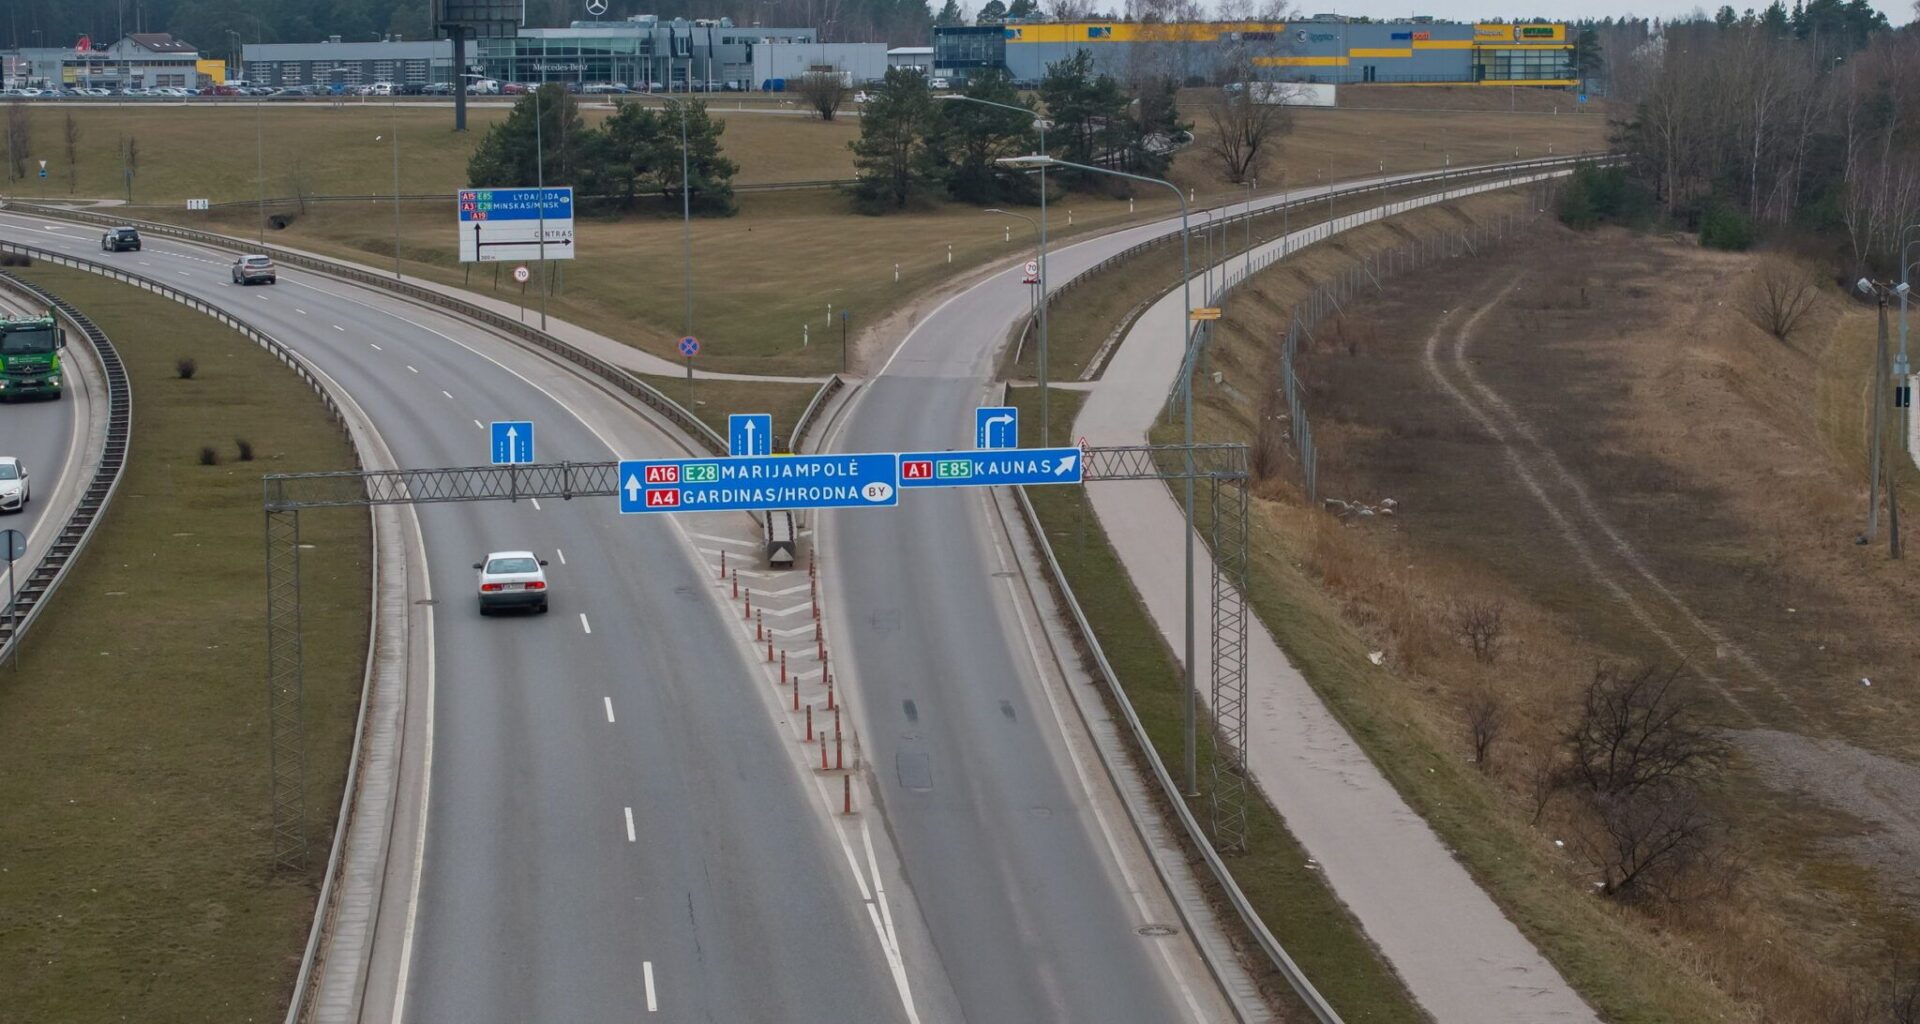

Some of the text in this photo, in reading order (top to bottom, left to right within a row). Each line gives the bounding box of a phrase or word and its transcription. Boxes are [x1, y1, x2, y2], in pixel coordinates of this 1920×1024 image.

[513, 193, 559, 201] LYDA/IDA
[493, 201, 559, 209] MINSKAS/MNSK
[534, 230, 572, 238] CNTRAS
[649, 458, 858, 481] A16 E28 MARIJAMPOLĖ
[909, 460, 1050, 477] A1 E85 KAUNAS
[652, 486, 886, 505] A4 GARDINAS/HRODNA BY
